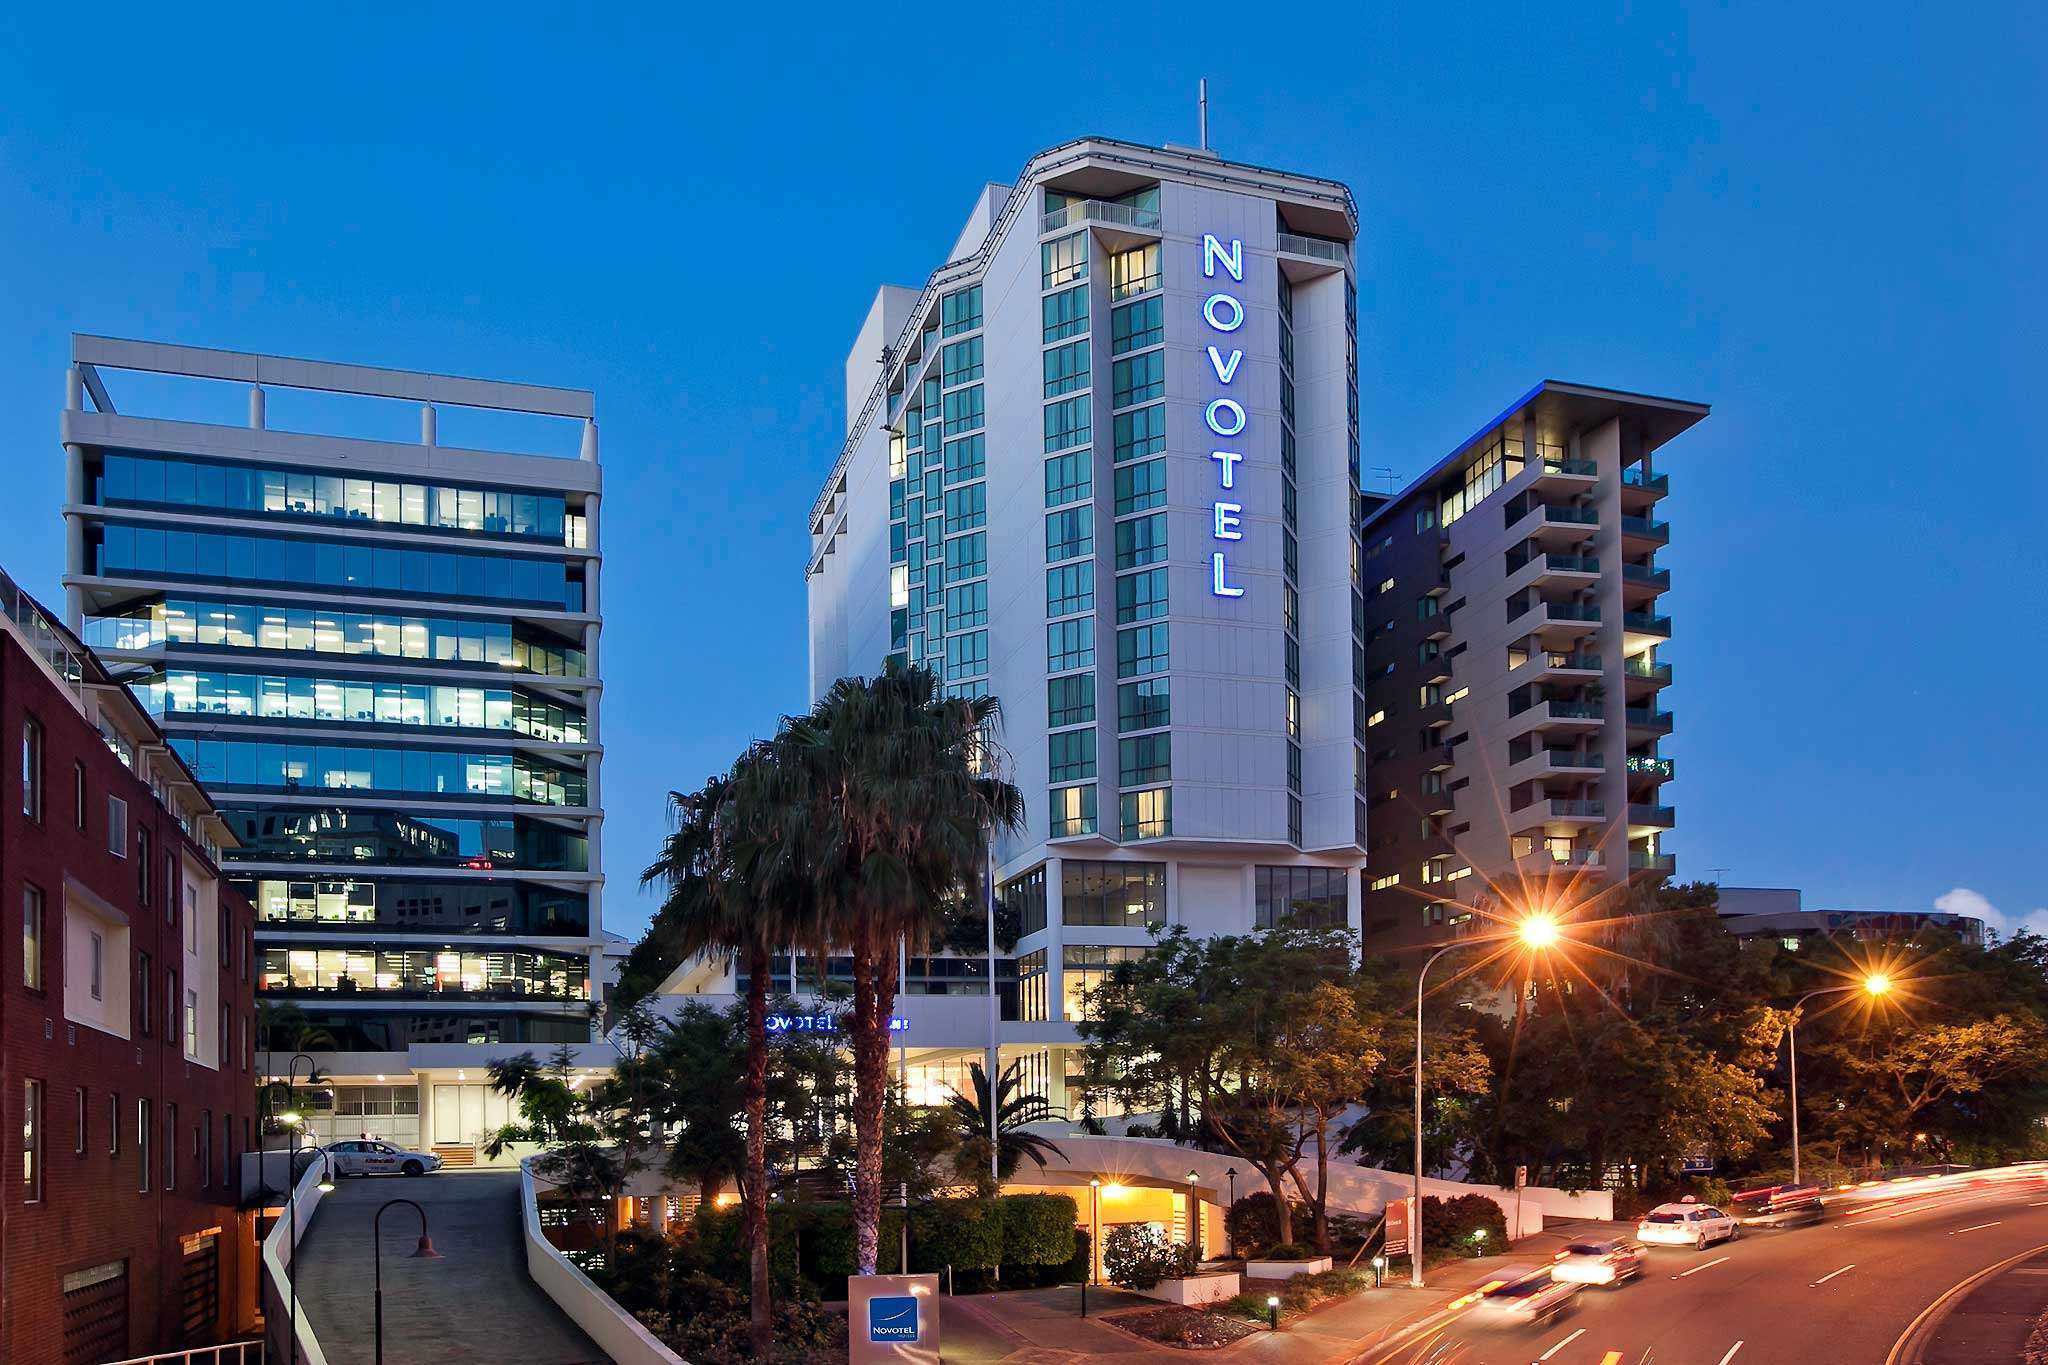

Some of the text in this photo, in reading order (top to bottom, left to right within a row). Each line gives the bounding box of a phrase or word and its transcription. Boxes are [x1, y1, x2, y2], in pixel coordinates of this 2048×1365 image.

[1203, 234, 1246, 597] NOVOTEL
[765, 1014, 838, 1031] OVOTEL
[873, 1326, 915, 1335] NOVOTEL
